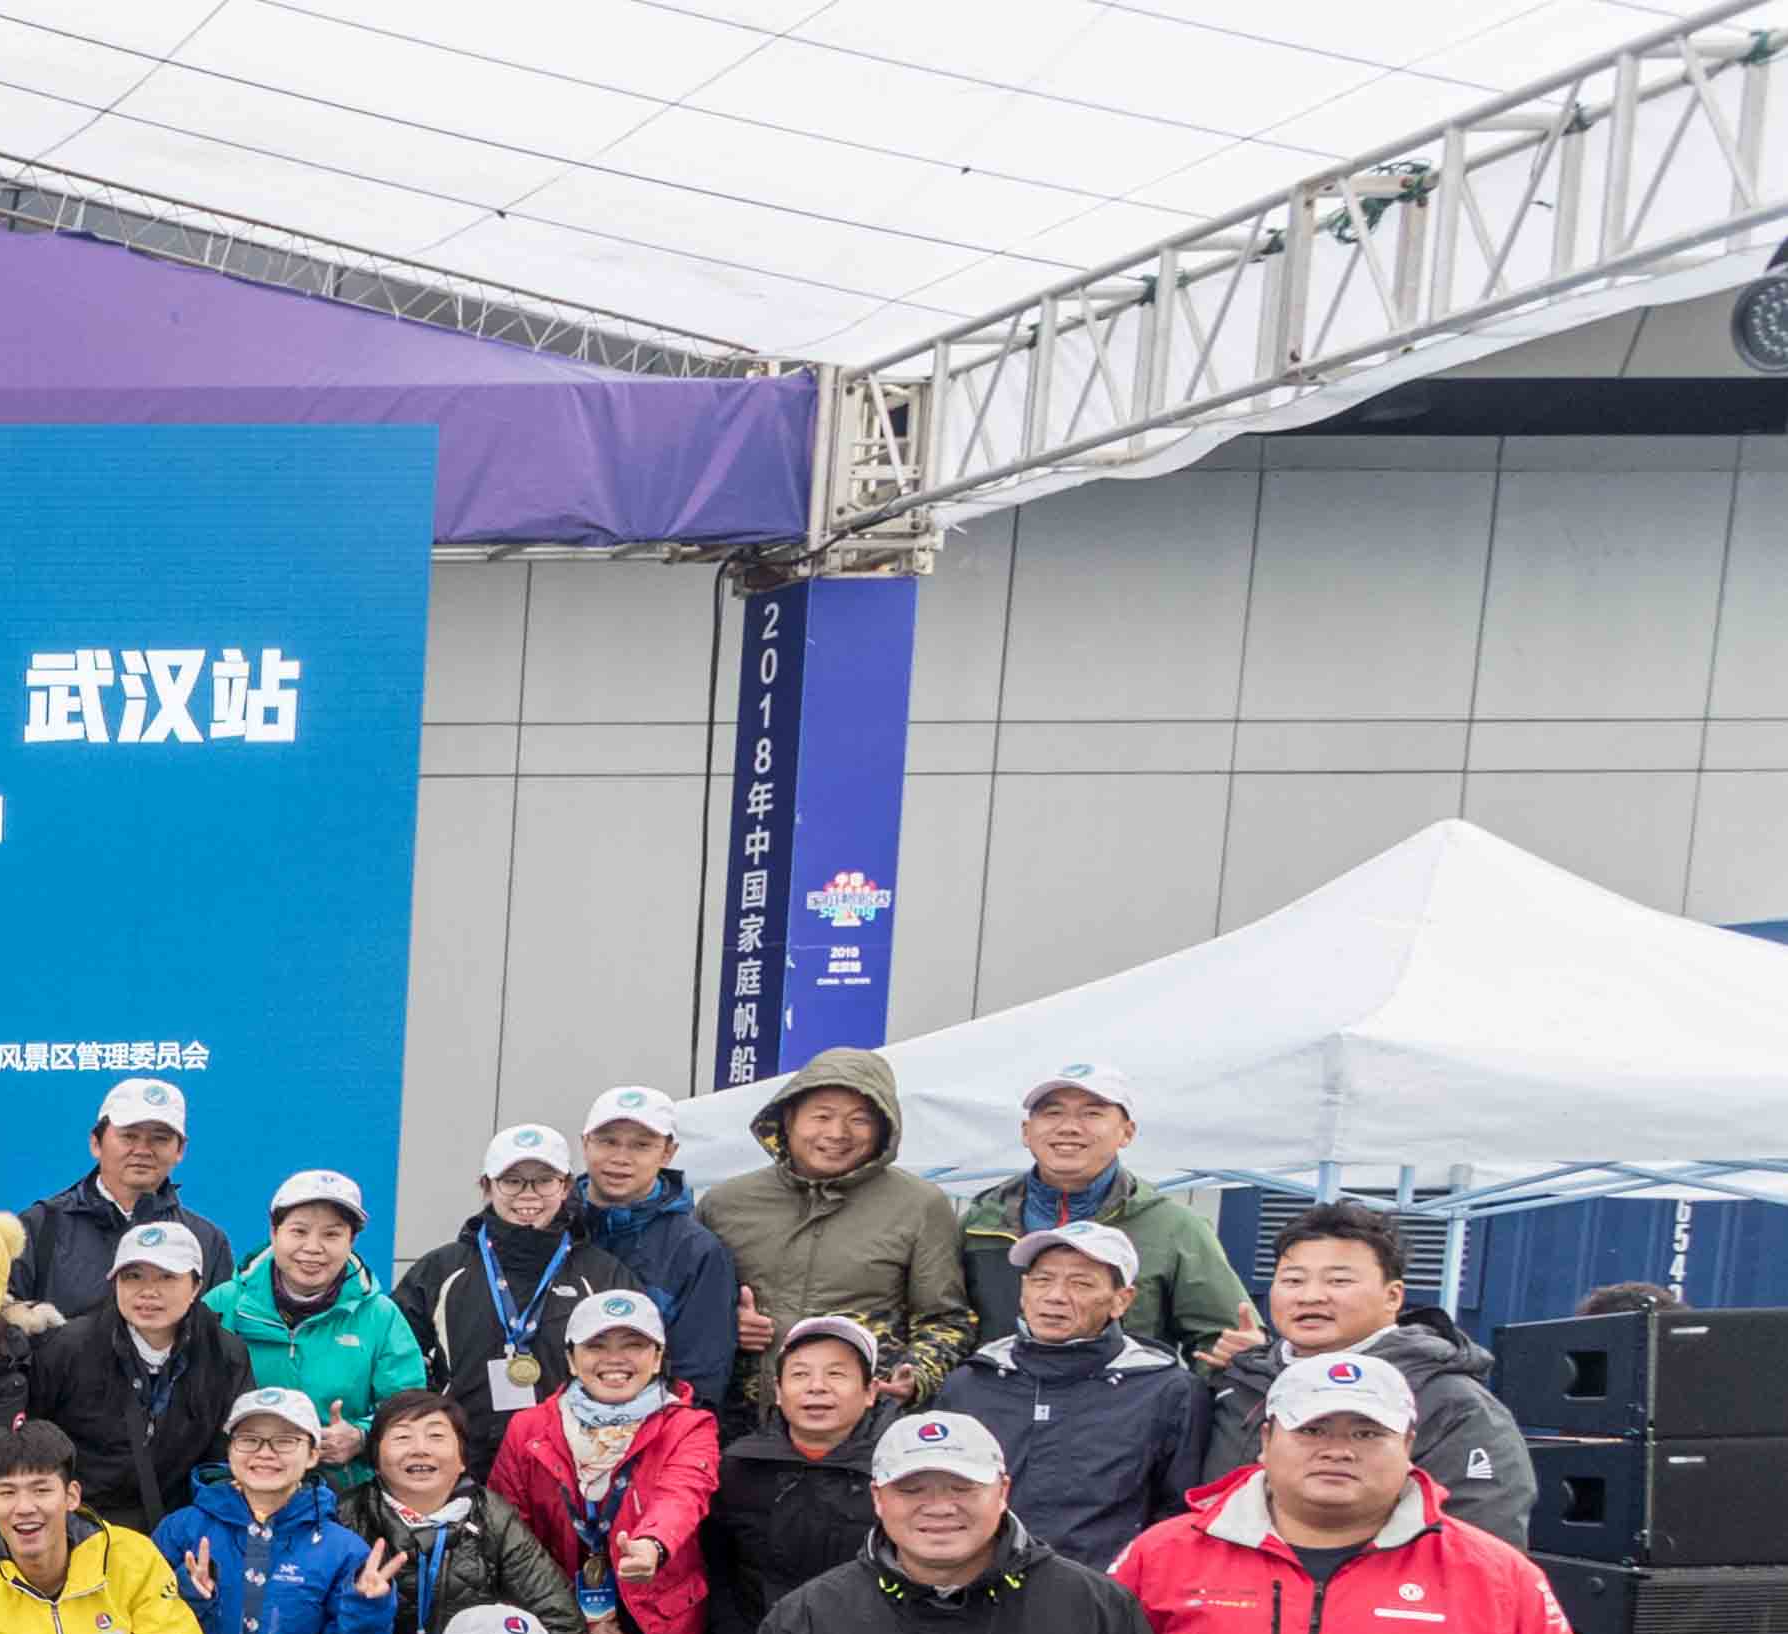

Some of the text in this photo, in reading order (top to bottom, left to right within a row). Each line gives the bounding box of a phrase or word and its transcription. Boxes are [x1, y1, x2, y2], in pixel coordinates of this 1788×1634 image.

[728, 602, 780, 1084] 2018年中国家庭帆船
